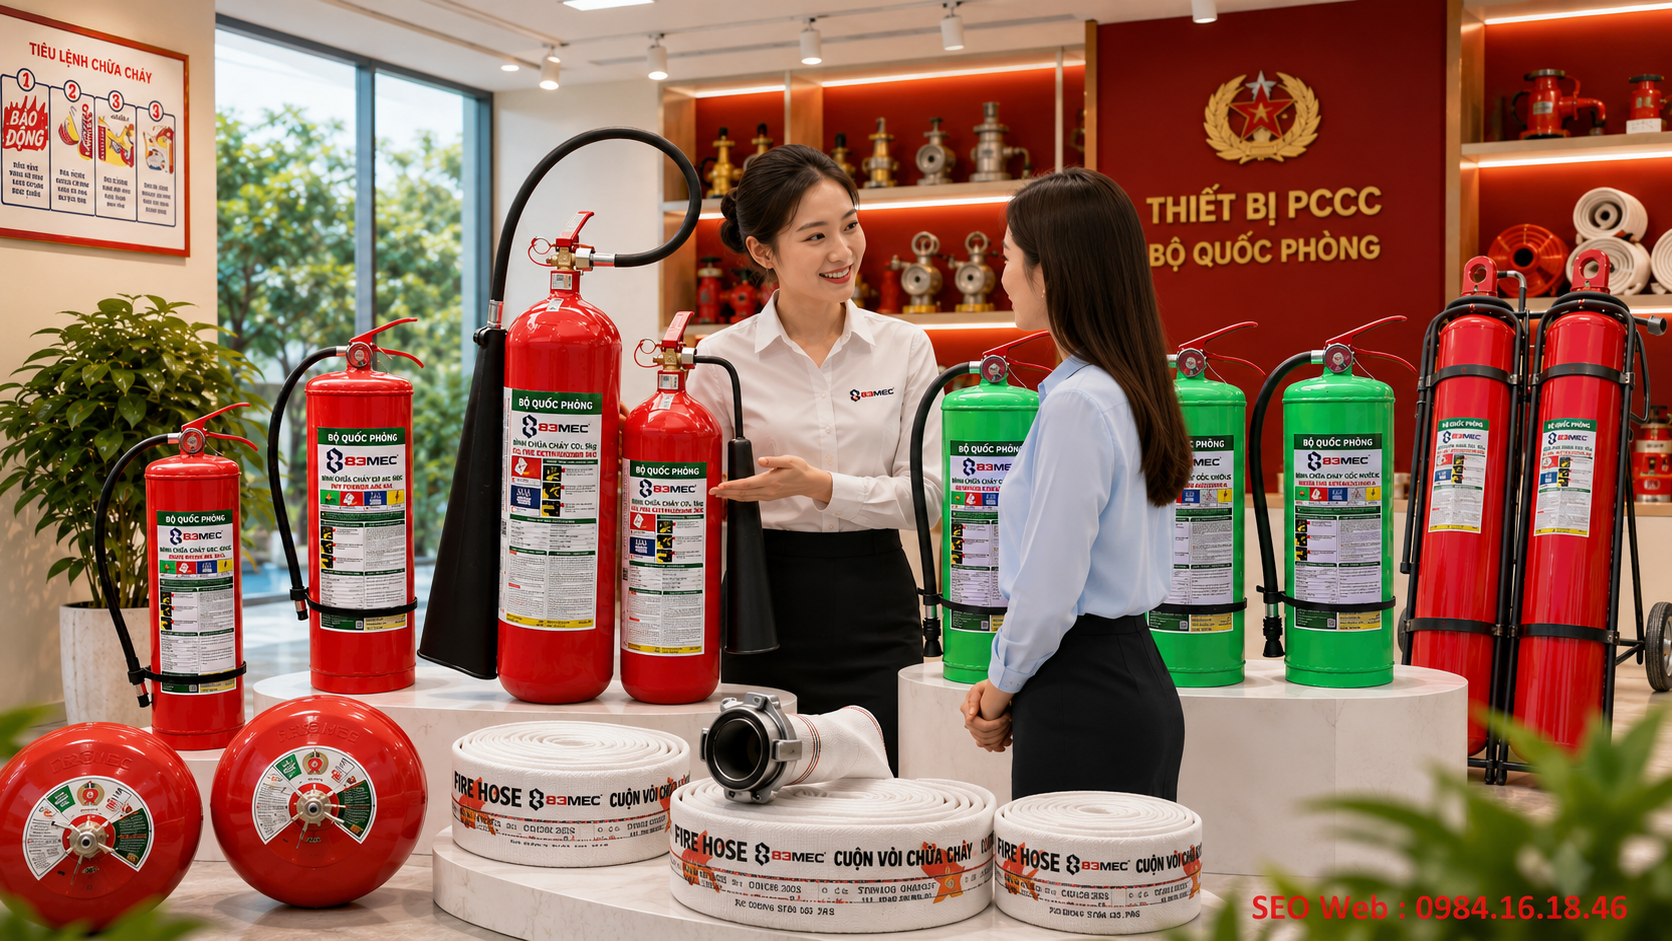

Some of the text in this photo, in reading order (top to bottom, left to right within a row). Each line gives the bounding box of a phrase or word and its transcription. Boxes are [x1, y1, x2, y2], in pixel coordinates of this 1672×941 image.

[29, 42, 56, 60] TIÊU
[59, 48, 88, 68] LỆNH
[22, 72, 30, 88] 1
[68, 83, 77, 100] 2
[112, 94, 120, 109] 3
[152, 103, 160, 119] 3
[5, 126, 45, 149] ĐỘNG
[1146, 183, 1382, 226] THIẾT BỊ PCCC
[1149, 230, 1381, 272] BỘ QUỐC PHÒNG
[1193, 458, 1220, 466] MEC
[454, 770, 474, 798] FIRE
[478, 781, 522, 807] HOSE
[610, 788, 640, 809] CUỘN
[675, 824, 698, 852] FIRE
[703, 835, 747, 862] HOSE
[834, 847, 873, 870] CUỘN
[878, 847, 902, 866] VÒI
[997, 837, 1017, 863] FIRE
[1020, 847, 1060, 872] HOSE
[1136, 854, 1164, 875] CUỘN
